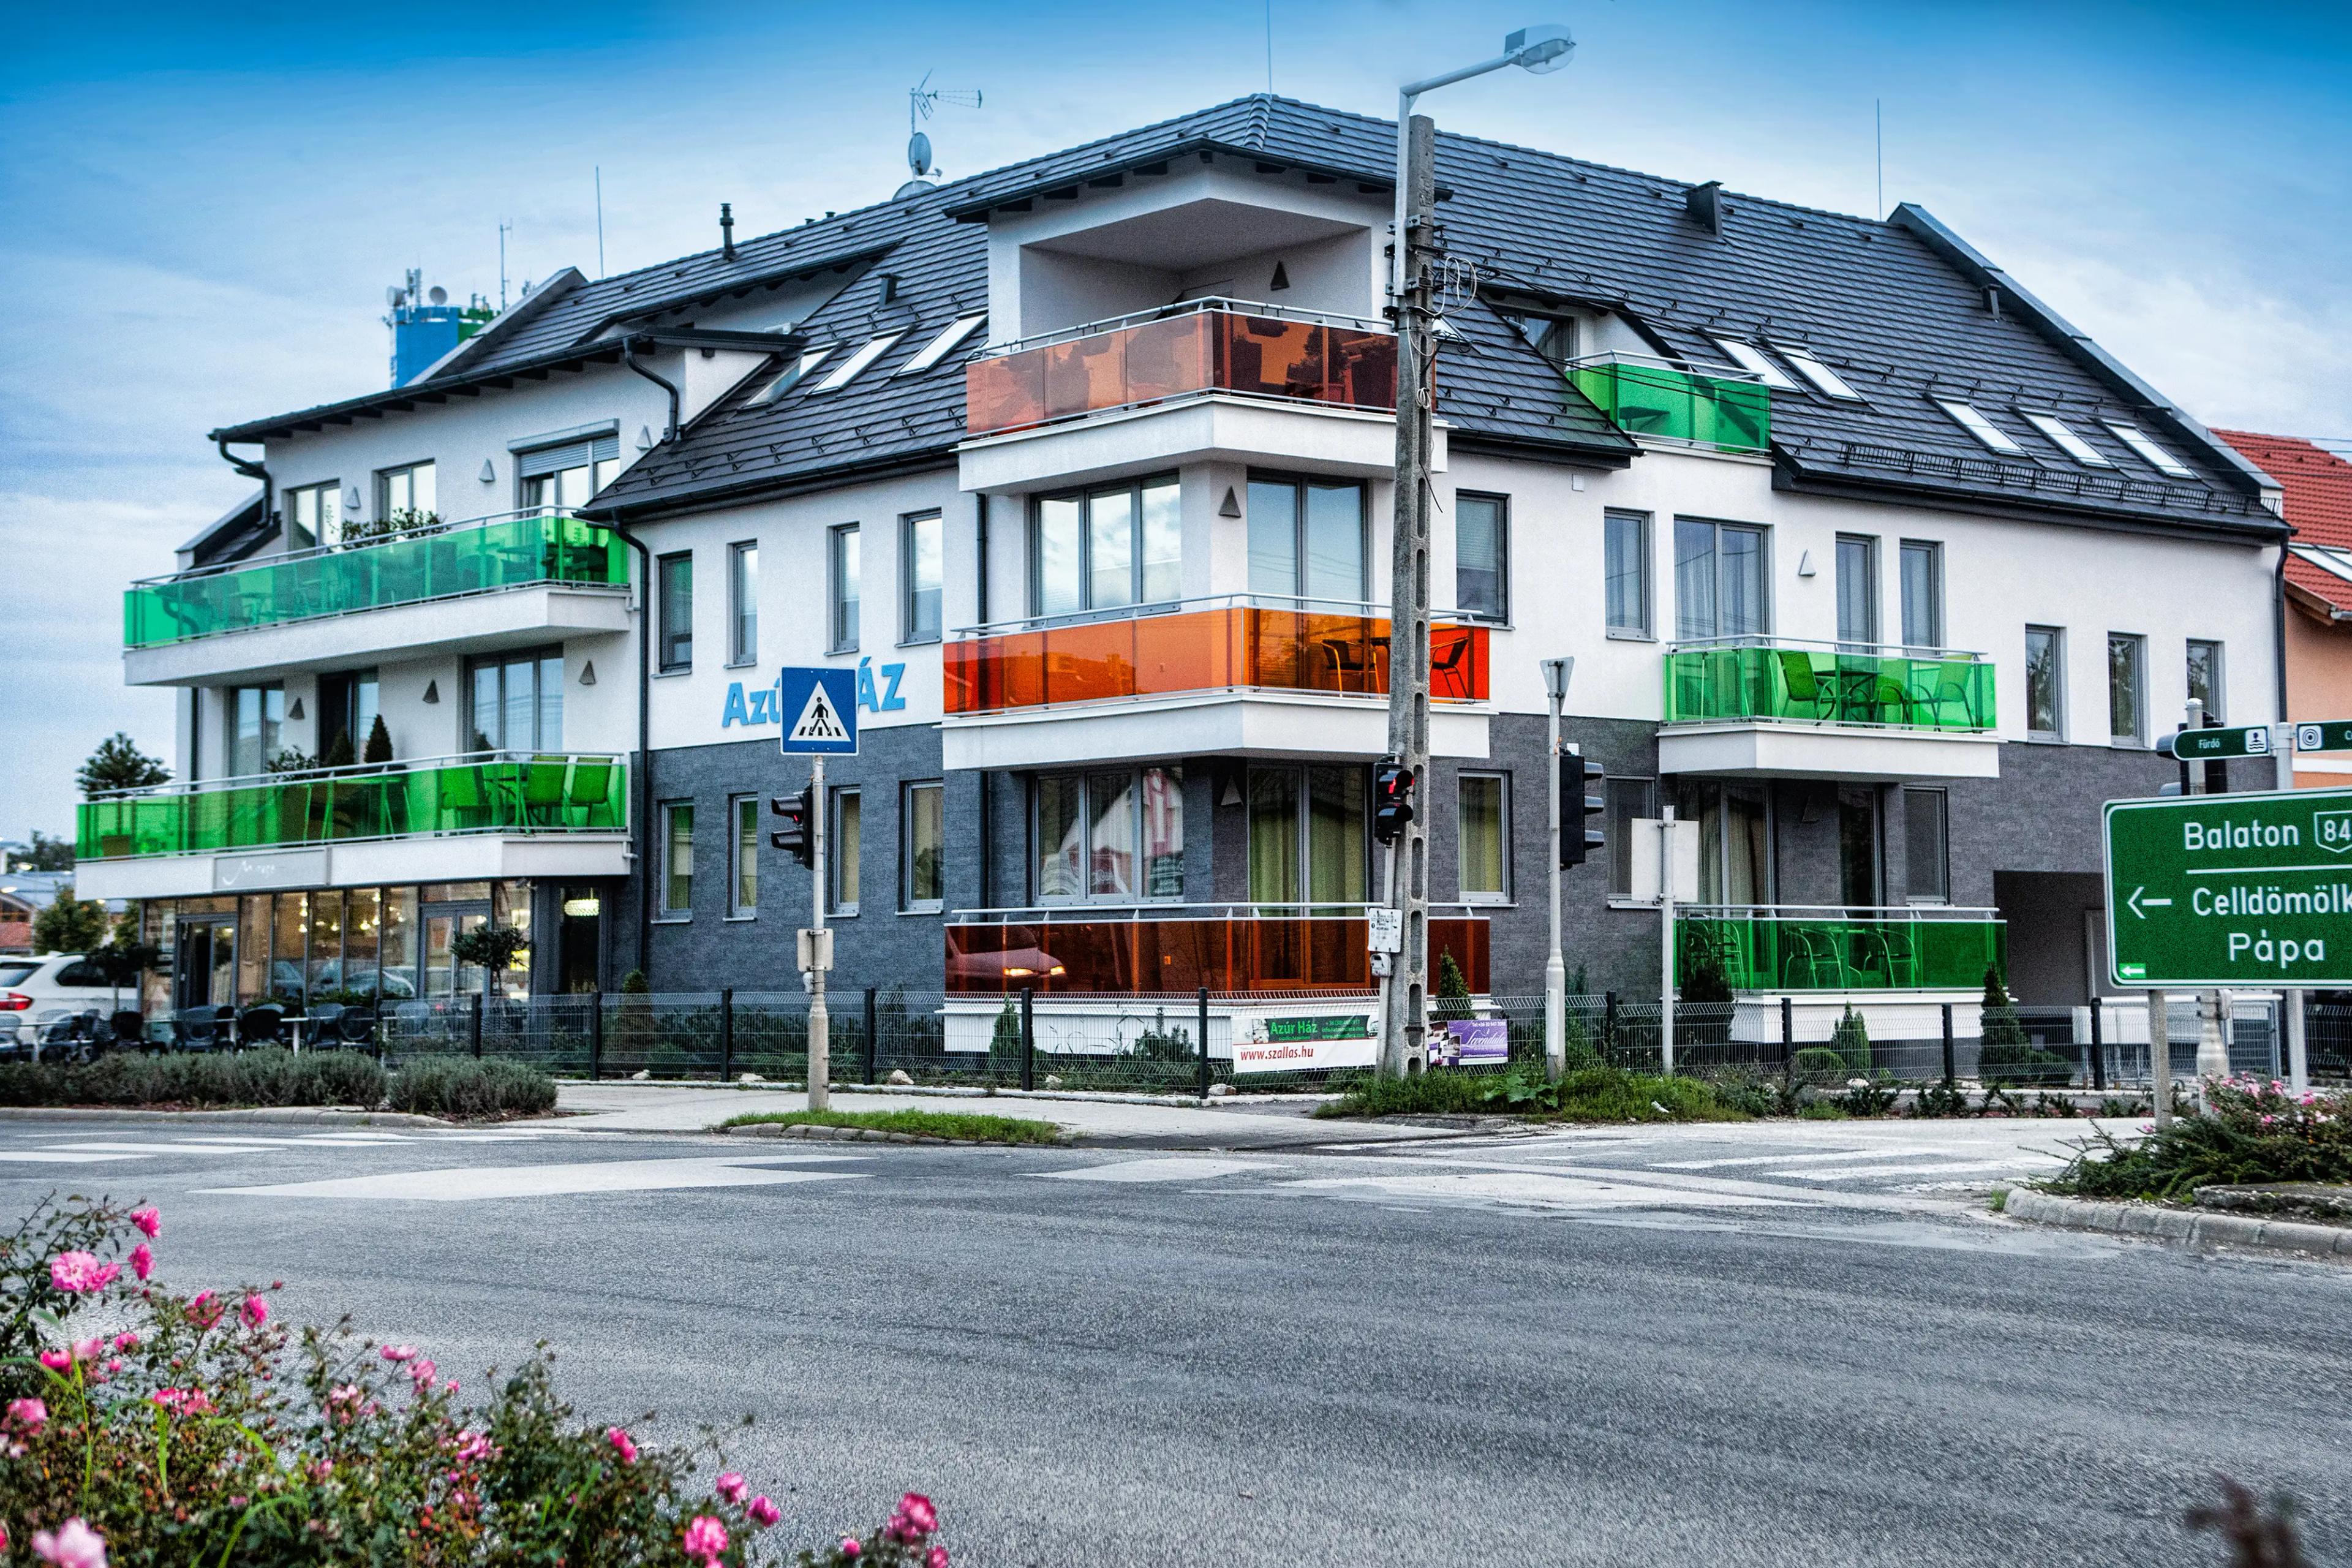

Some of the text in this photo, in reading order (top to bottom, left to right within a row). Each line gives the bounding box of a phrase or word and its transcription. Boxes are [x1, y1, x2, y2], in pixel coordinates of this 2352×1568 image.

[722, 656, 906, 727] Azú ÁZ
[2184, 819, 2352, 850] Balaton 84
[2228, 929, 2324, 969] Pápa
[1270, 1021, 1294, 1035] Azúr
[1298, 1020, 1317, 1033] Ház
[1240, 1046, 1314, 1061] www.szallas.hu
